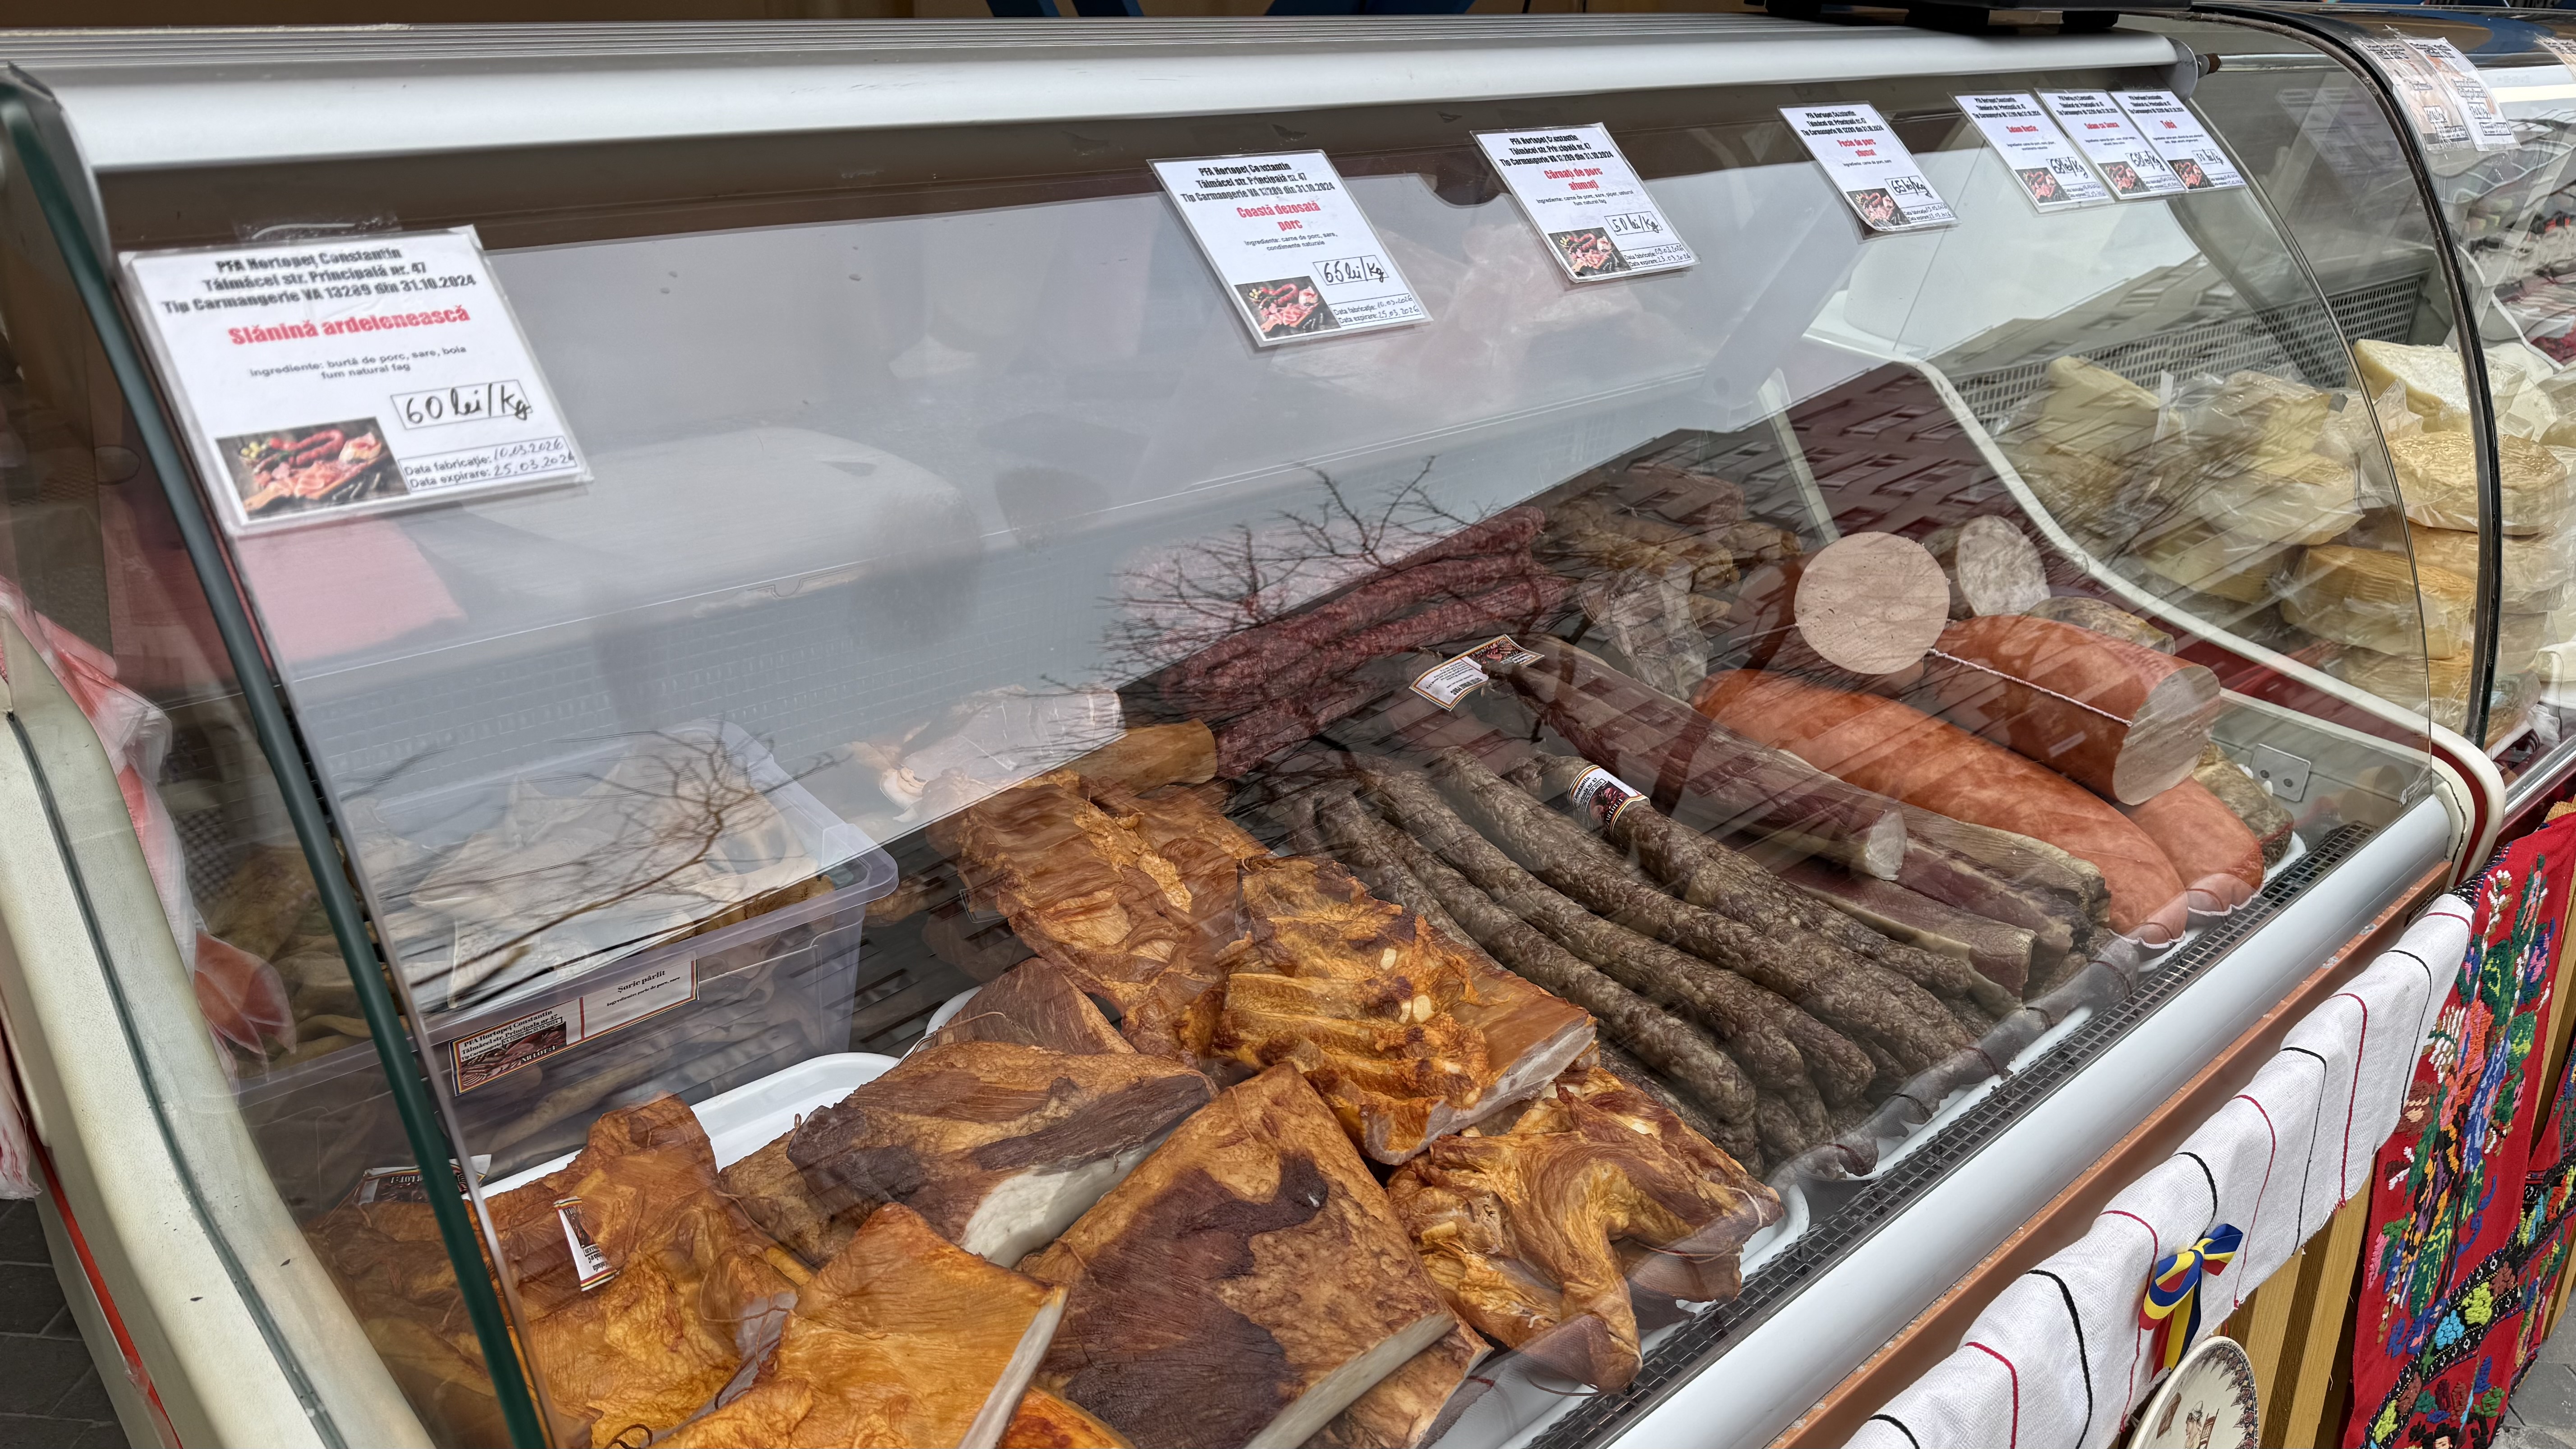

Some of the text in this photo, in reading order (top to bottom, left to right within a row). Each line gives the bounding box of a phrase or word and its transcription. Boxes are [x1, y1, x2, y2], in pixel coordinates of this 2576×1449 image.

[1198, 168, 1214, 176] PFA
[1248, 162, 1292, 172] Constantin
[1544, 168, 1603, 179] Cârnați de porc
[1180, 194, 1196, 202] Tip
[1195, 190, 1248, 201] Carmangerie
[1247, 189, 1260, 197] VA
[1259, 186, 1283, 196] 13289
[1295, 182, 1335, 193] 31.10.2024
[1569, 180, 1599, 190] afumați
[1891, 180, 1907, 193] 65
[1237, 201, 1320, 218] Coastă dezosată
[1277, 220, 1302, 231] porc
[1612, 217, 1628, 232] 50
[318, 248, 402, 264] Constantin
[412, 262, 426, 273] 47
[1324, 261, 1344, 282] 65
[162, 301, 190, 313] Tip
[193, 291, 300, 310] Carmangerie
[302, 289, 323, 300] VA
[374, 282, 400, 294] din
[400, 275, 476, 291] 31.10.2024
[228, 305, 470, 345] Slănină ardelenească
[380, 354, 409, 366] porc,
[349, 363, 389, 376] natural
[406, 396, 443, 424] 60
[404, 465, 432, 476] Data
[410, 475, 436, 488] Data
[440, 469, 491, 485] expirare:
[618, 970, 665, 993] Șoric pârlit
[513, 1010, 552, 1028] Constantin
